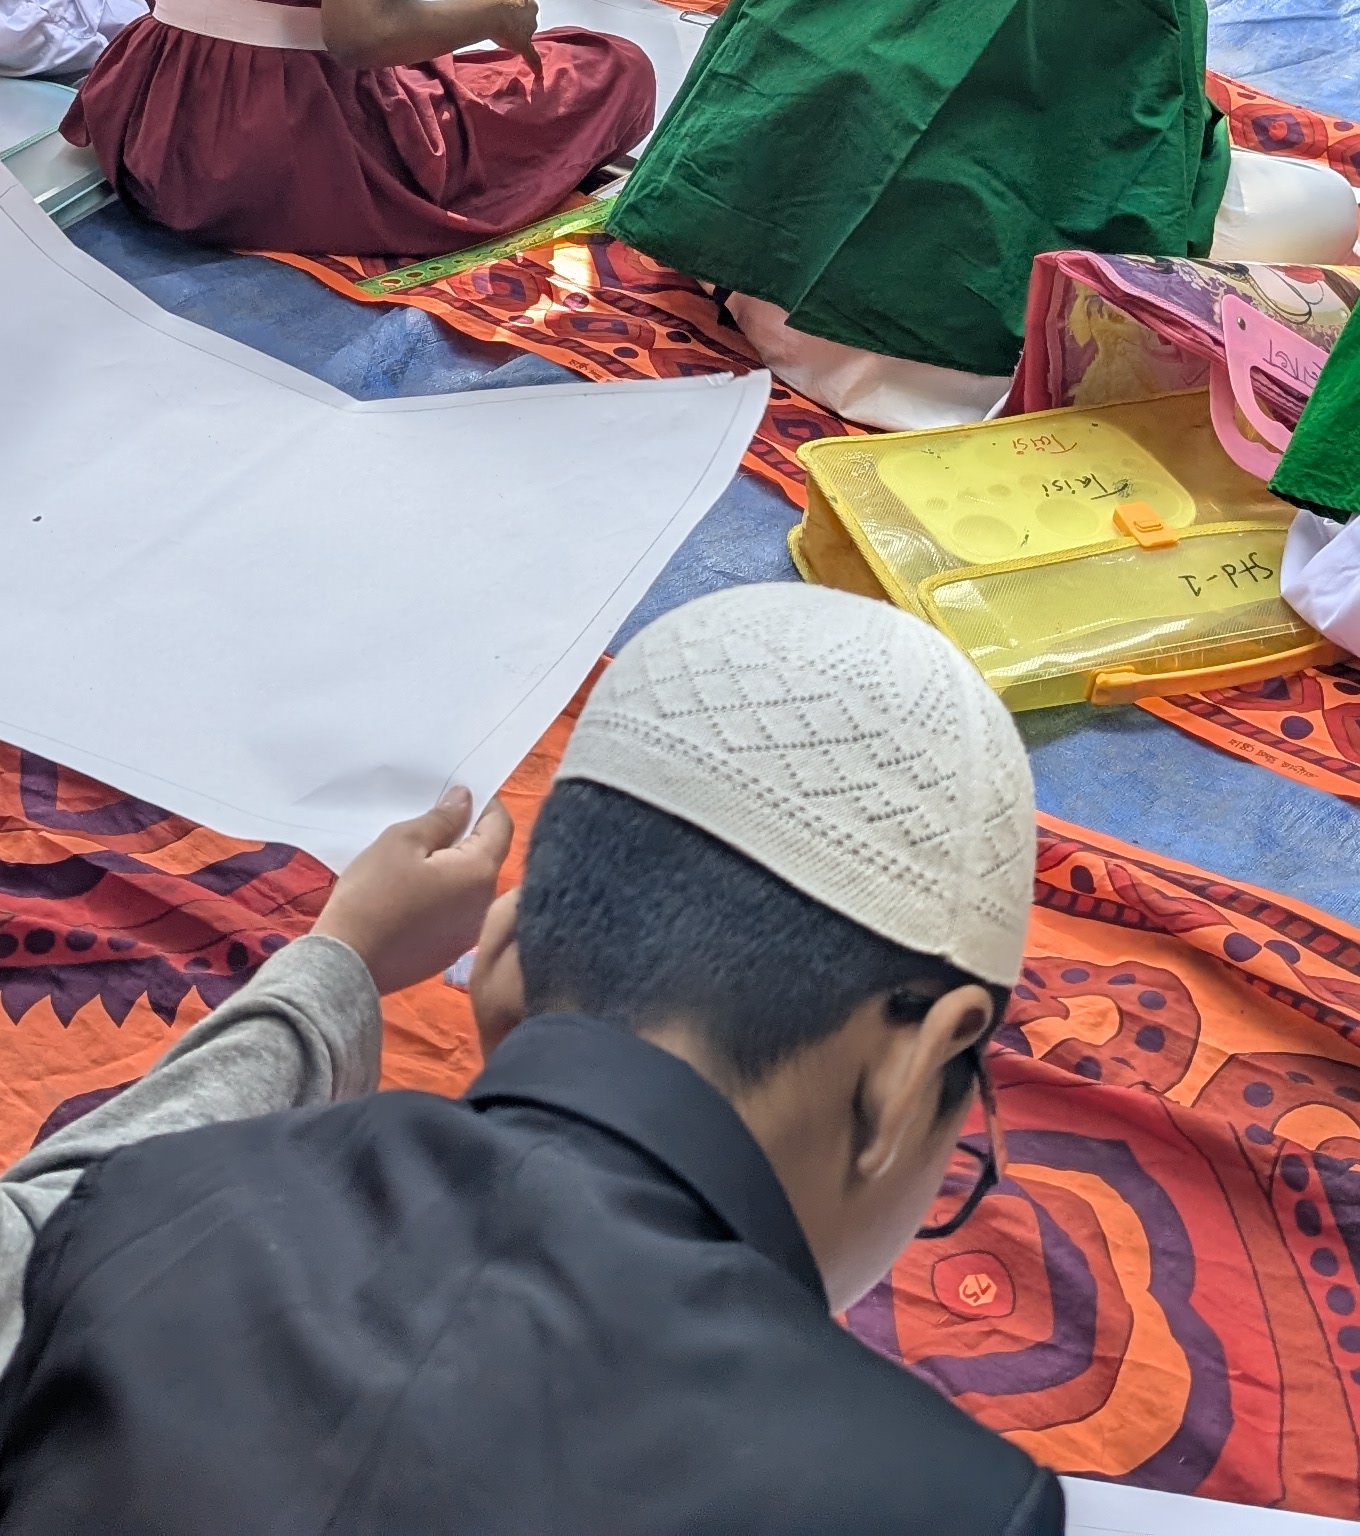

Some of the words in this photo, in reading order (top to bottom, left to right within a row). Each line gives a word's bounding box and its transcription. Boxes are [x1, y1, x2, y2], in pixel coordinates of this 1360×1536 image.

[1011, 432, 1079, 456] Taisi
[1041, 472, 1129, 501] Taisi
[1177, 550, 1275, 598] Std-1
